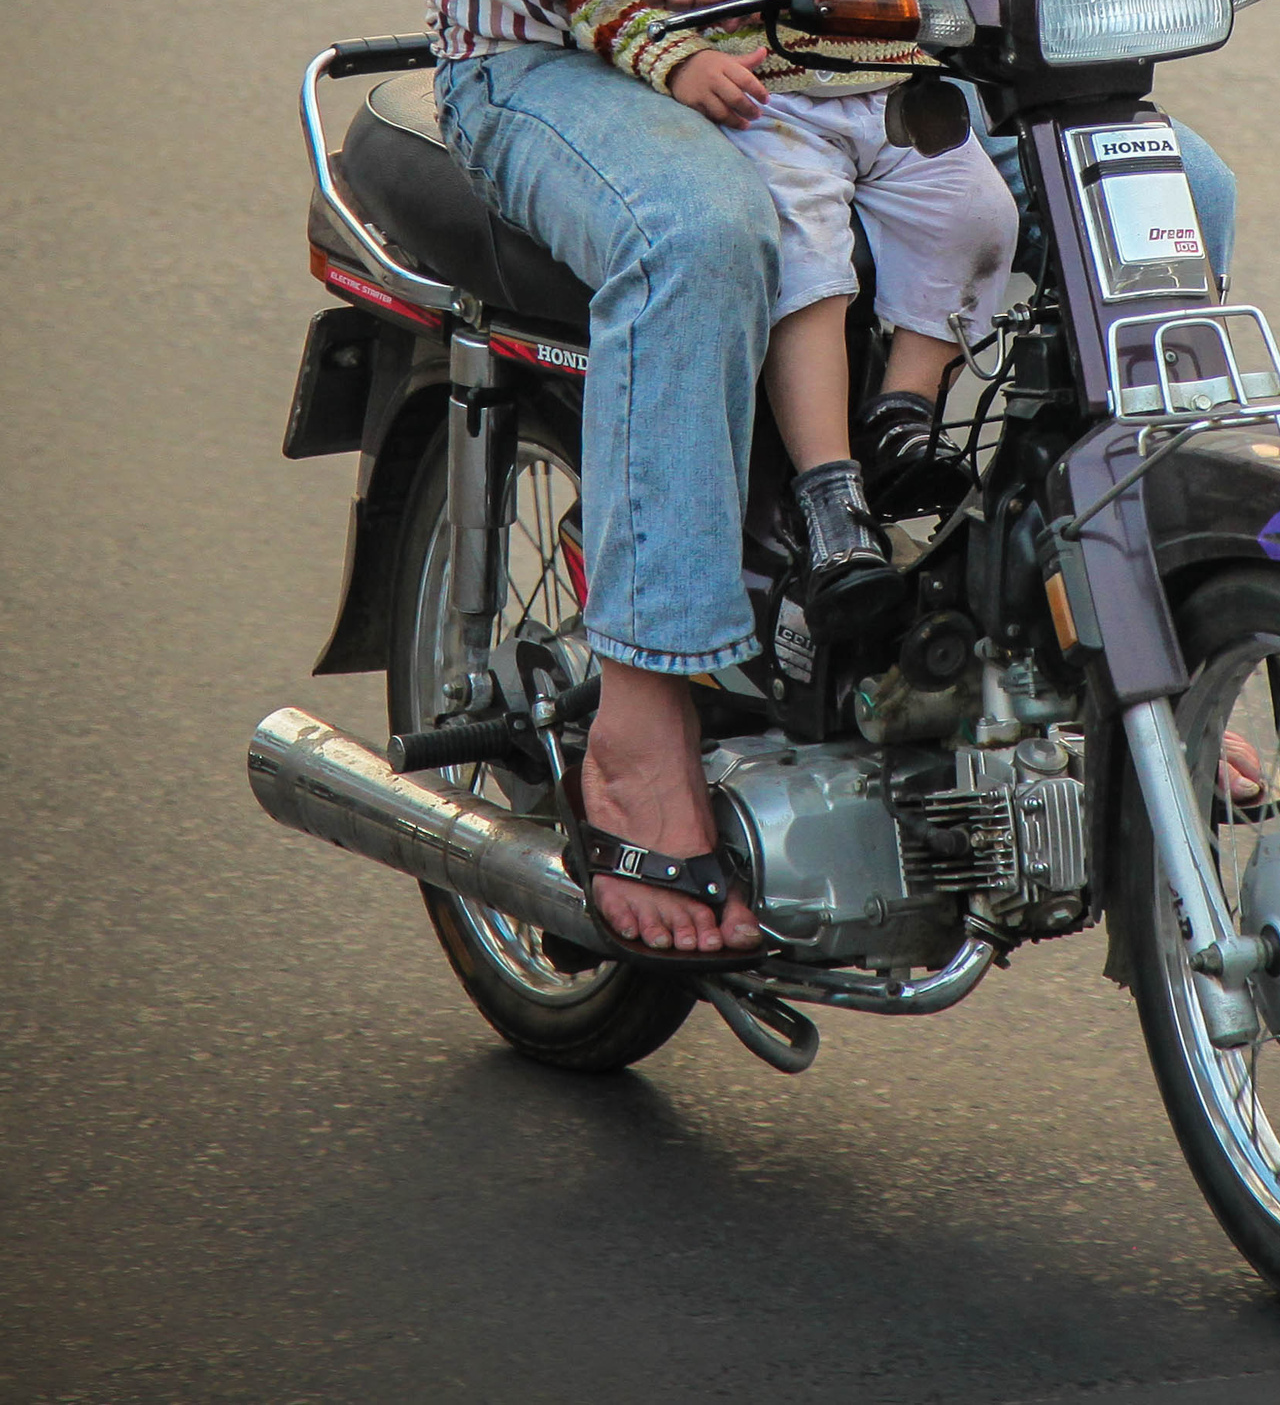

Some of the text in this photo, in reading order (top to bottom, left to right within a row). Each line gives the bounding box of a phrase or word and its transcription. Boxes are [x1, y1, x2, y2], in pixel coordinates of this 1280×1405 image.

[1102, 140, 1174, 156] HONDA
[1149, 228, 1195, 241] Dream
[1175, 241, 1199, 252] 100
[330, 271, 393, 305] ELECTRIC STARTER
[537, 343, 589, 371] HOND
